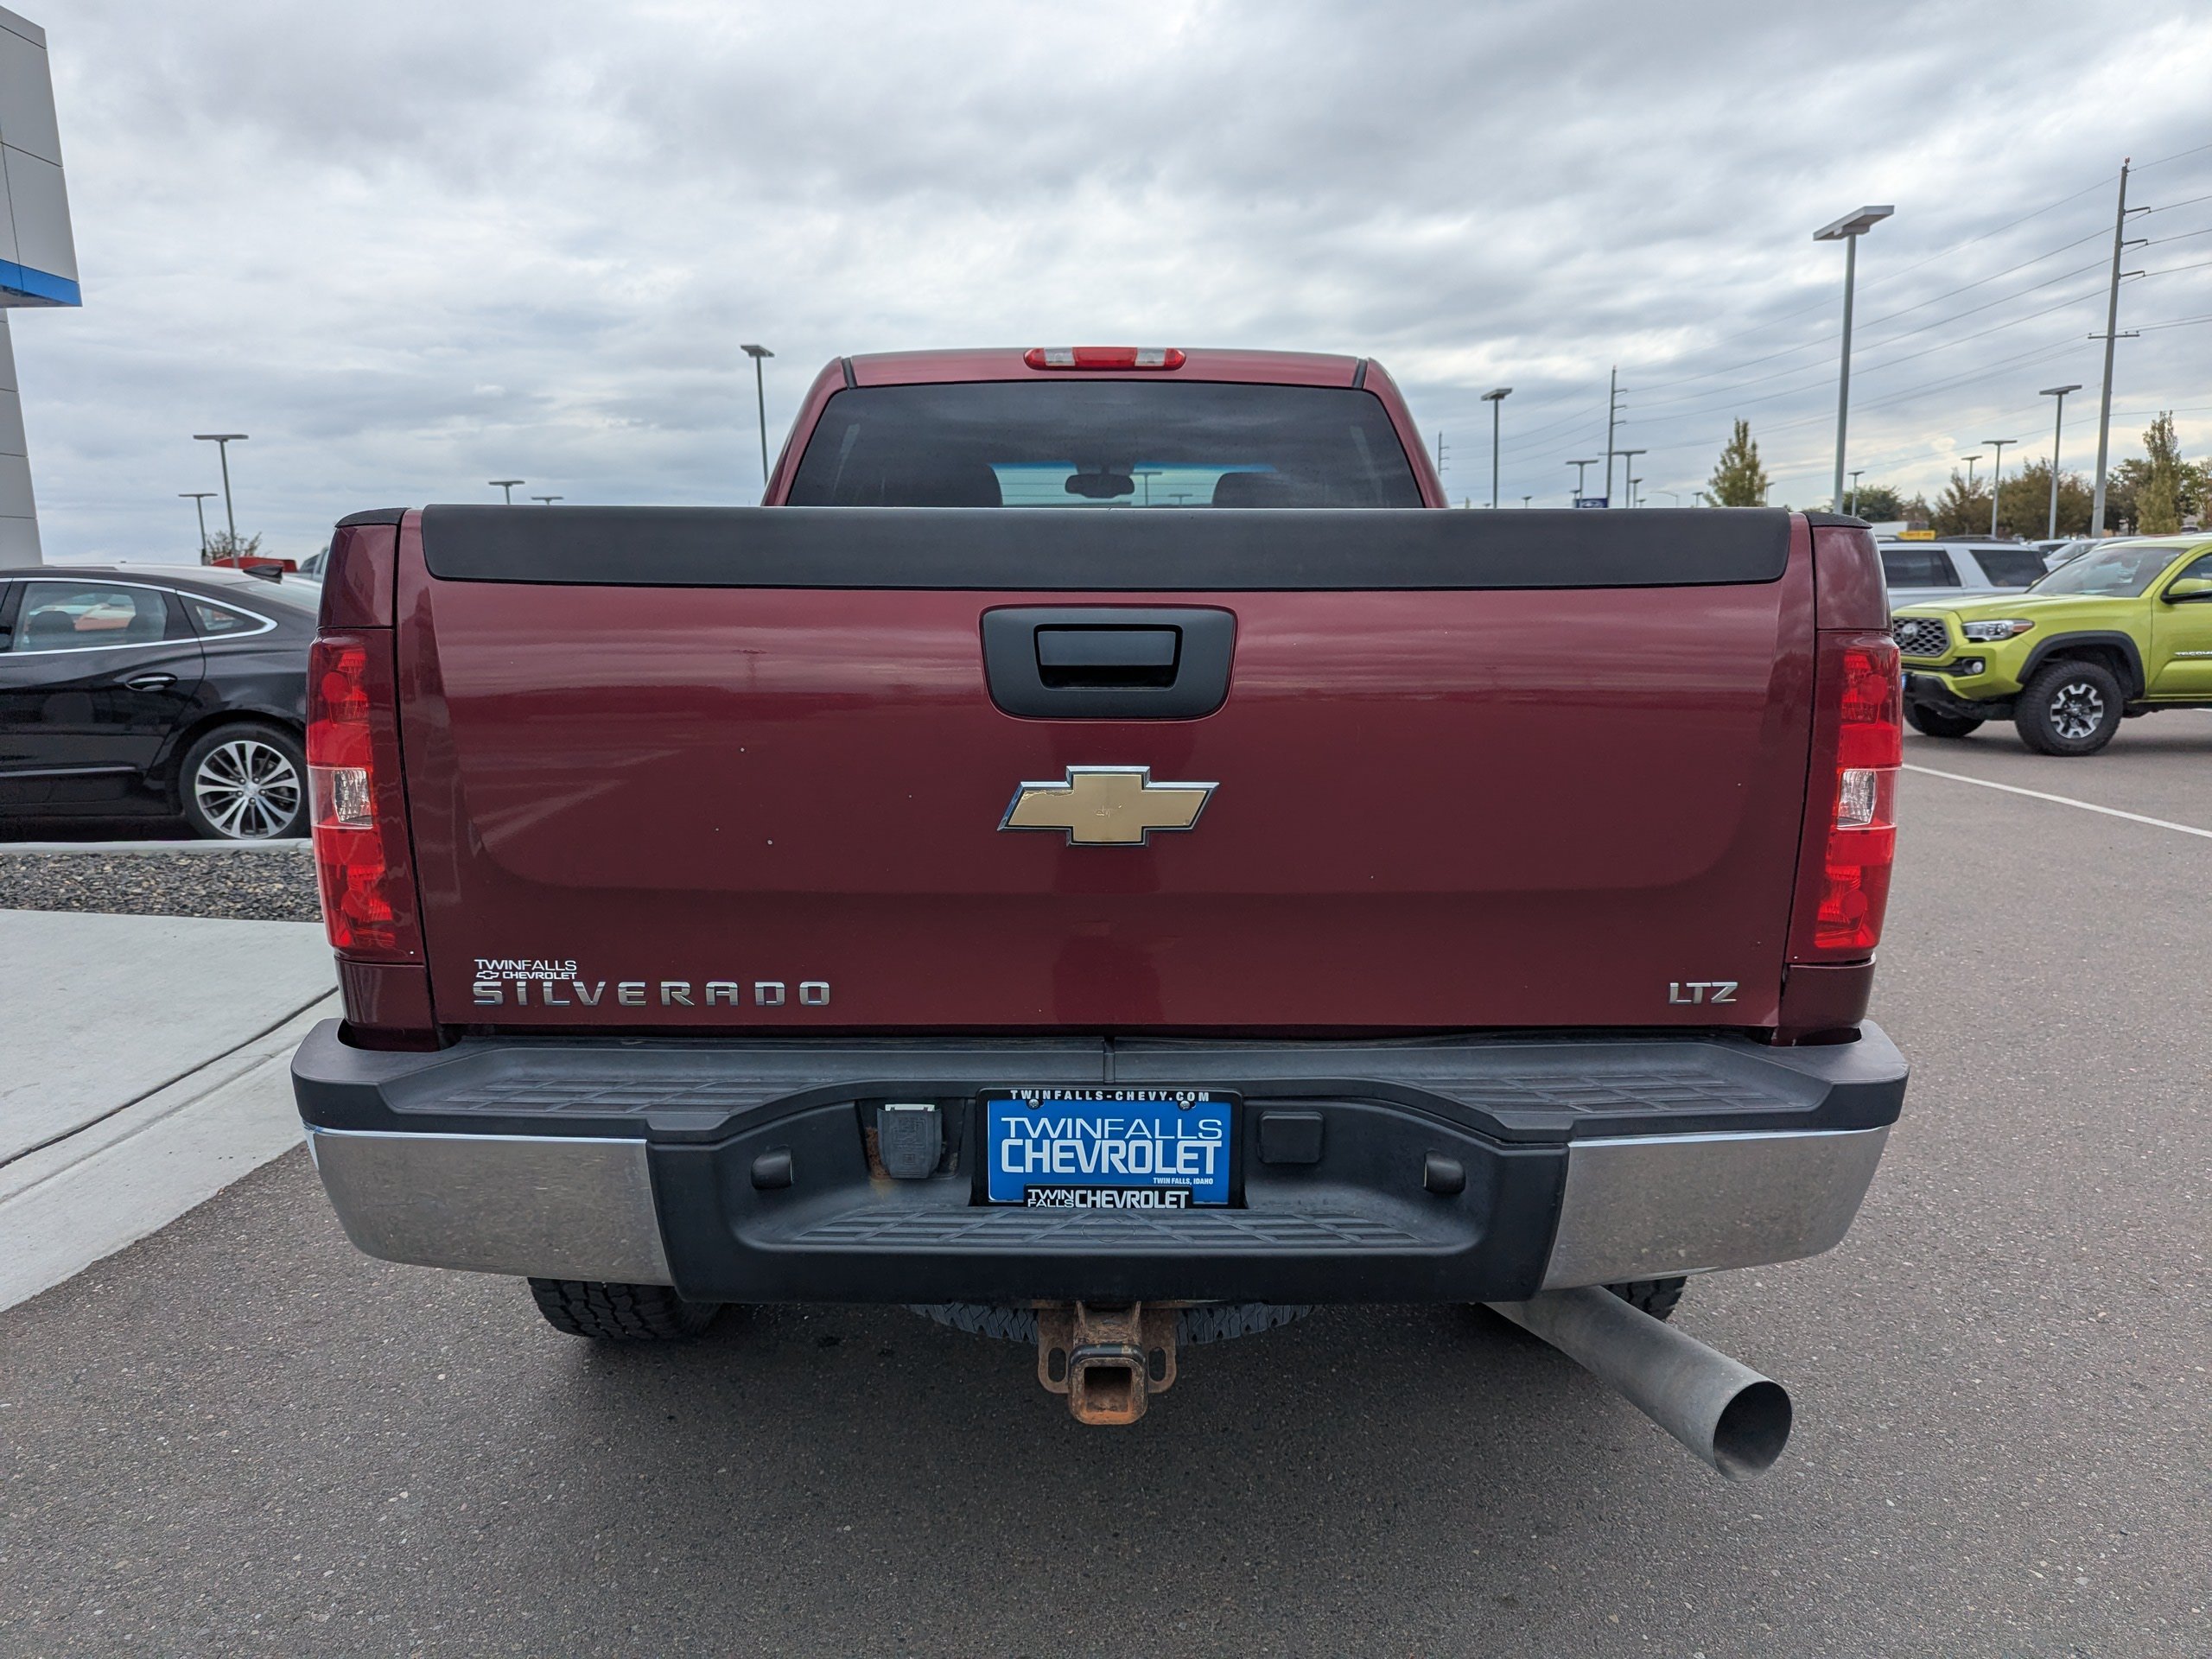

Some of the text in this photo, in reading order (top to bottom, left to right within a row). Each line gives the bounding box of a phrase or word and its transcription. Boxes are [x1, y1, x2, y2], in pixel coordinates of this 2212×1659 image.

[474, 959, 577, 971] TWINFALLS
[502, 971, 577, 980] CHEVROLET
[473, 981, 831, 1006] SILVERADO
[1669, 982, 1738, 1004] LTZ
[1010, 1090, 1210, 1102] TWINFALLS-CHEVY.COM
[1001, 1117, 1223, 1141] TWINFALLS
[1001, 1139, 1223, 1174] CHEVROLET
[1171, 1177, 1192, 1185] FALLS,
[1027, 1189, 1074, 1199] TWIN
[1075, 1190, 1190, 1209] CHEVROLET
[1027, 1198, 1075, 1208] FALLS
